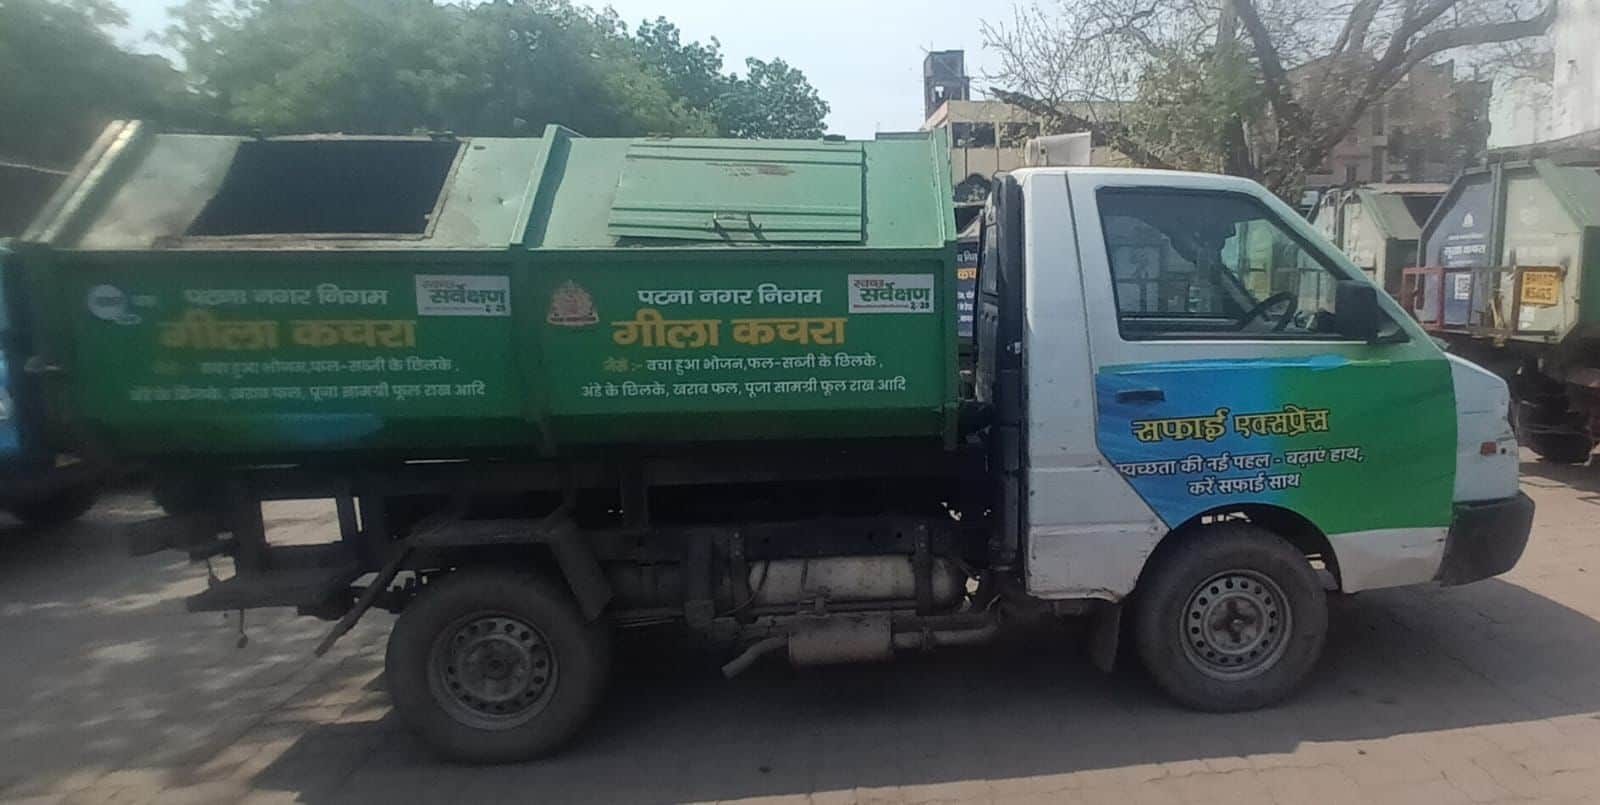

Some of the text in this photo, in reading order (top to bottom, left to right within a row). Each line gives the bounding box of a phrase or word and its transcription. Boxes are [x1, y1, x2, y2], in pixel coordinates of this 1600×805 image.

[253, 289, 312, 306] नगर
[316, 282, 390, 306] निगम
[637, 282, 824, 306] पटना नगर निगम
[860, 278, 932, 302] सर्वेक्षण
[287, 318, 417, 349] कचरा
[611, 307, 849, 349] गीला कचरा
[674, 358, 701, 376] हुआ
[817, 354, 832, 369] के
[581, 381, 603, 398] अंडे
[604, 382, 620, 397] के
[744, 379, 772, 399] पूजा
[773, 377, 818, 394] सामग्री
[819, 378, 847, 397] फूल
[848, 378, 874, 392] राख
[877, 375, 908, 393] आदि
[1132, 403, 1330, 443] सफाई एक्सप्रेस
[1179, 453, 1204, 474] की
[1206, 452, 1230, 473] नई
[1232, 451, 1272, 469] पहल
[1330, 445, 1364, 463] हाथ,
[1188, 471, 1301, 496] करें सफाई साथ
